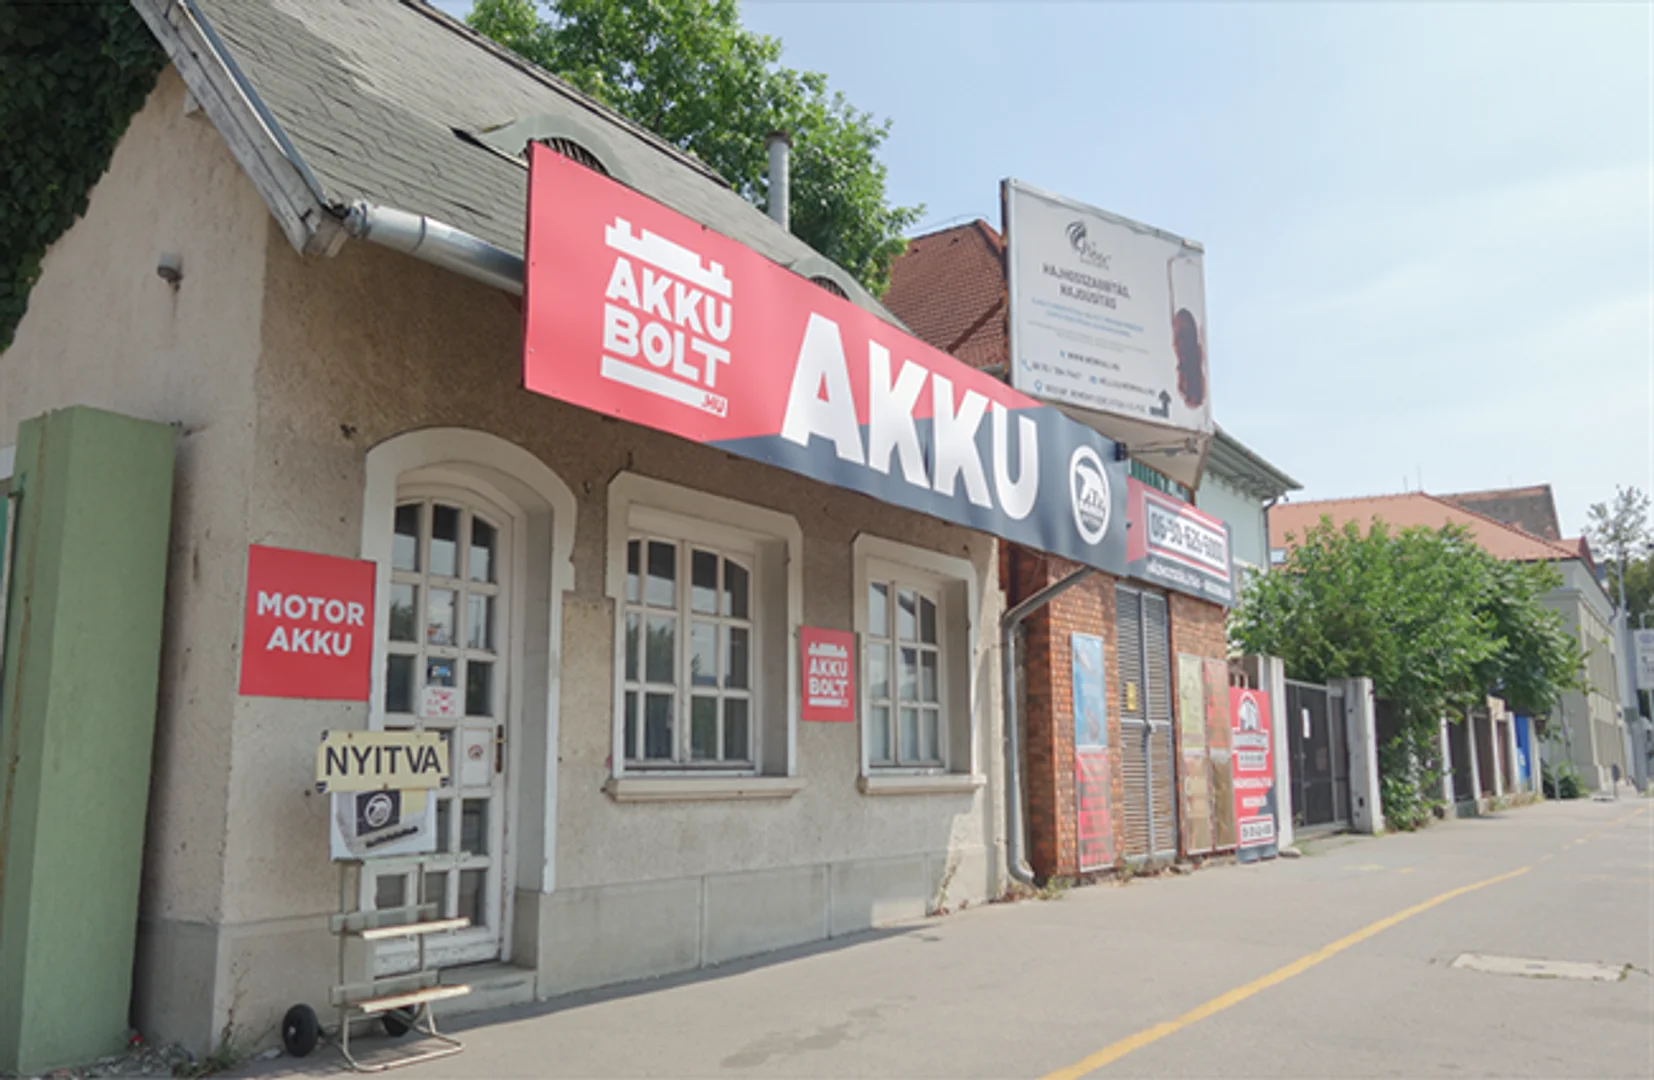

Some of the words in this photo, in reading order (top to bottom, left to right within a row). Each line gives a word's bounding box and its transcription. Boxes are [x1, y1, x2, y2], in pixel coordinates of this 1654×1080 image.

[605, 256, 732, 342] AKKU
[603, 302, 731, 388] BOLT
[781, 311, 1039, 521] AKKU
[256, 591, 364, 627] MOTOR
[266, 626, 352, 656] AKKU
[808, 657, 848, 678] AKKU
[808, 677, 848, 697] BOLT
[325, 744, 442, 777] NYITVA
